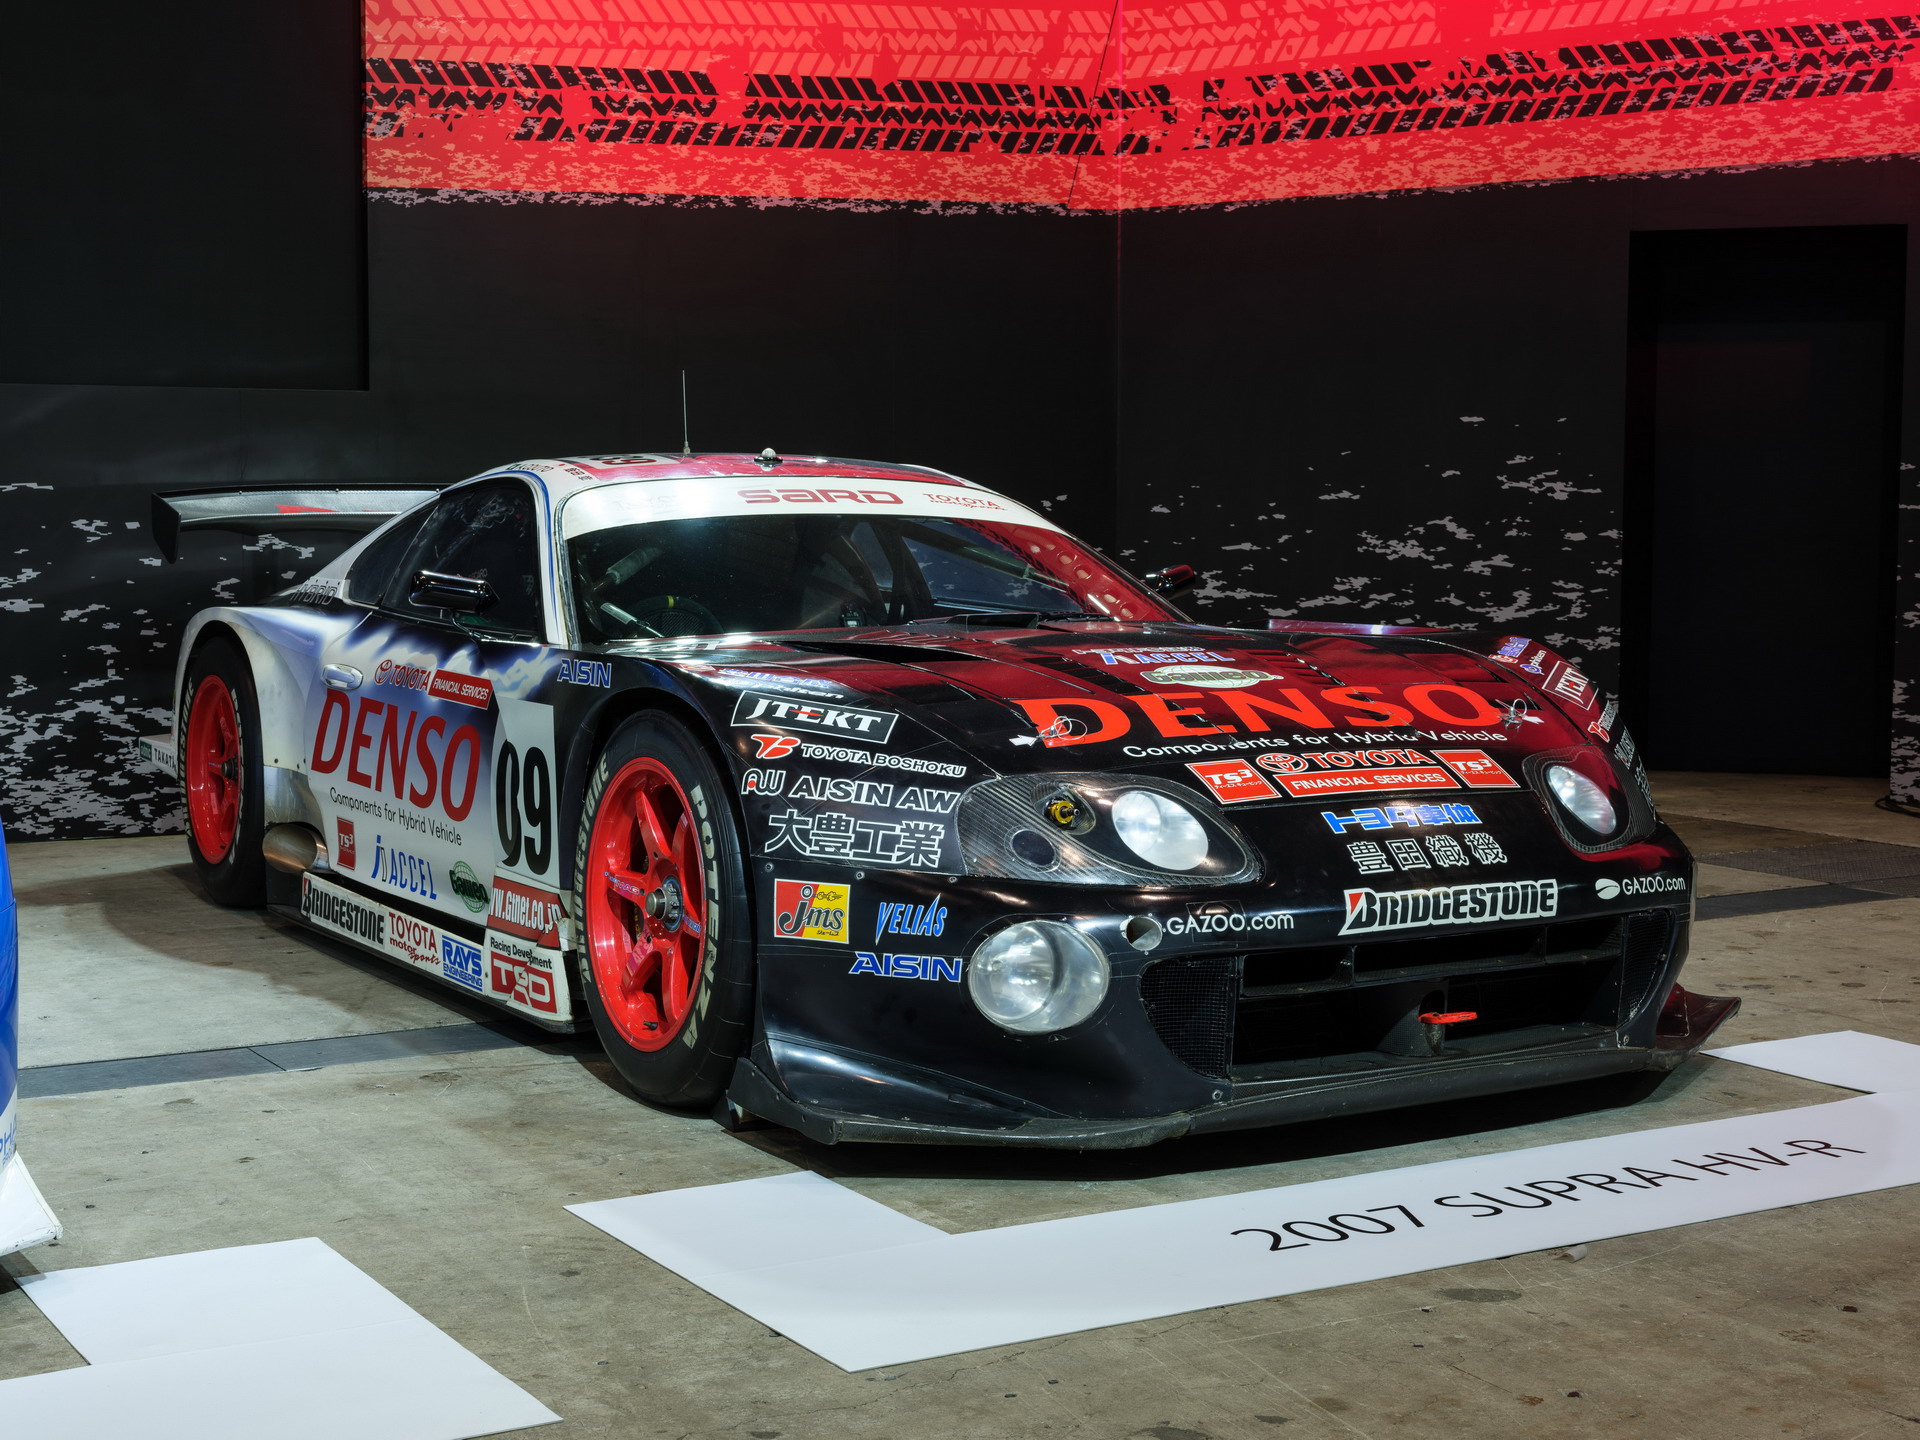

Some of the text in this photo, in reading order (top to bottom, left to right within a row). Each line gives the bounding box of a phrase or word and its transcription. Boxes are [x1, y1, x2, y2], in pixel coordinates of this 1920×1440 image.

[923, 493, 1001, 507] TOYOTA
[389, 663, 489, 701] TOYOTA FINANCIAL SERVICES
[556, 658, 612, 688] AISIN
[1554, 666, 1590, 705] JTEKT
[746, 698, 882, 732] JTEKT
[1011, 685, 1501, 748] DENSO
[310, 688, 481, 822] DENSO
[800, 743, 967, 777] TOYOTA BOSHOKU
[1122, 737, 1290, 759] Components
[1292, 734, 1332, 748] for
[1416, 729, 1508, 744] Vehicle
[1301, 748, 1436, 769] TOYOTA
[788, 775, 894, 807] AISIN
[896, 787, 961, 814] AW
[1291, 772, 1446, 791] FINANCIAL SERVICES
[329, 786, 462, 846] Components for Hybrid Vehicle
[1321, 803, 1483, 834] トヨタ車体
[764, 808, 945, 868] 大豊工業
[1346, 833, 1507, 875] 豊田織機
[389, 848, 437, 900] ACCEL
[1622, 877, 1686, 895] GAZOO.com
[302, 876, 384, 946] BRIDGESTONE
[682, 784, 720, 1050] POTENZA
[876, 893, 947, 945] VELIAS
[1166, 913, 1294, 935] GAZOO.com
[1338, 878, 1559, 936] BRIDGESTONE
[389, 912, 437, 953] TOYOTA
[390, 937, 417, 955] motor
[490, 937, 511, 957] Racing
[442, 940, 482, 977] RAYS
[443, 964, 483, 988] ENGINEERING
[849, 952, 962, 982] AISIN
[1230, 1139, 1867, 1252] 2007 SUPRA HV-R
